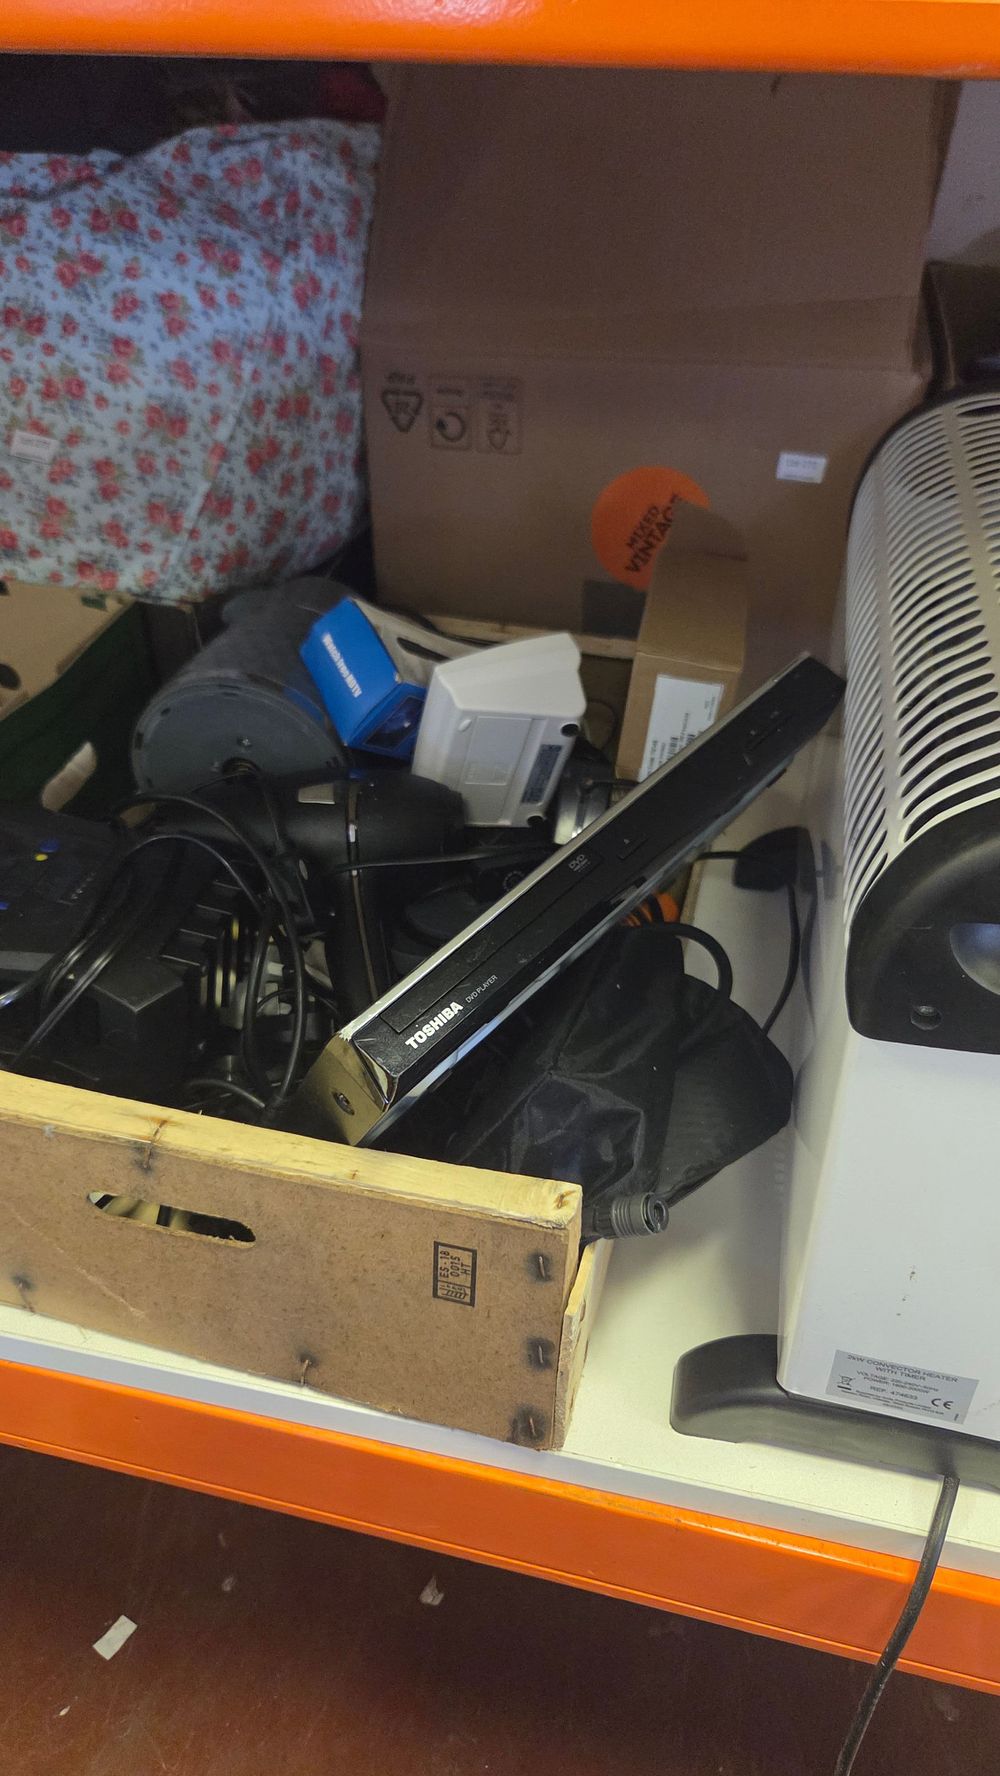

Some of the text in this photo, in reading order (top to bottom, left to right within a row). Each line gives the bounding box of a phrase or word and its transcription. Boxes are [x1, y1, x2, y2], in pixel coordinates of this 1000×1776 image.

[625, 505, 661, 548] MIXED
[405, 974, 498, 1049] TOSHIBA DVD PLAYER
[450, 1255, 460, 1277] 0015
[461, 1262, 471, 1275] HT
[866, 1358, 921, 1374] CONVECTOR
[923, 1370, 959, 1383] HEATER
[875, 1366, 926, 1382] WITH TIMER
